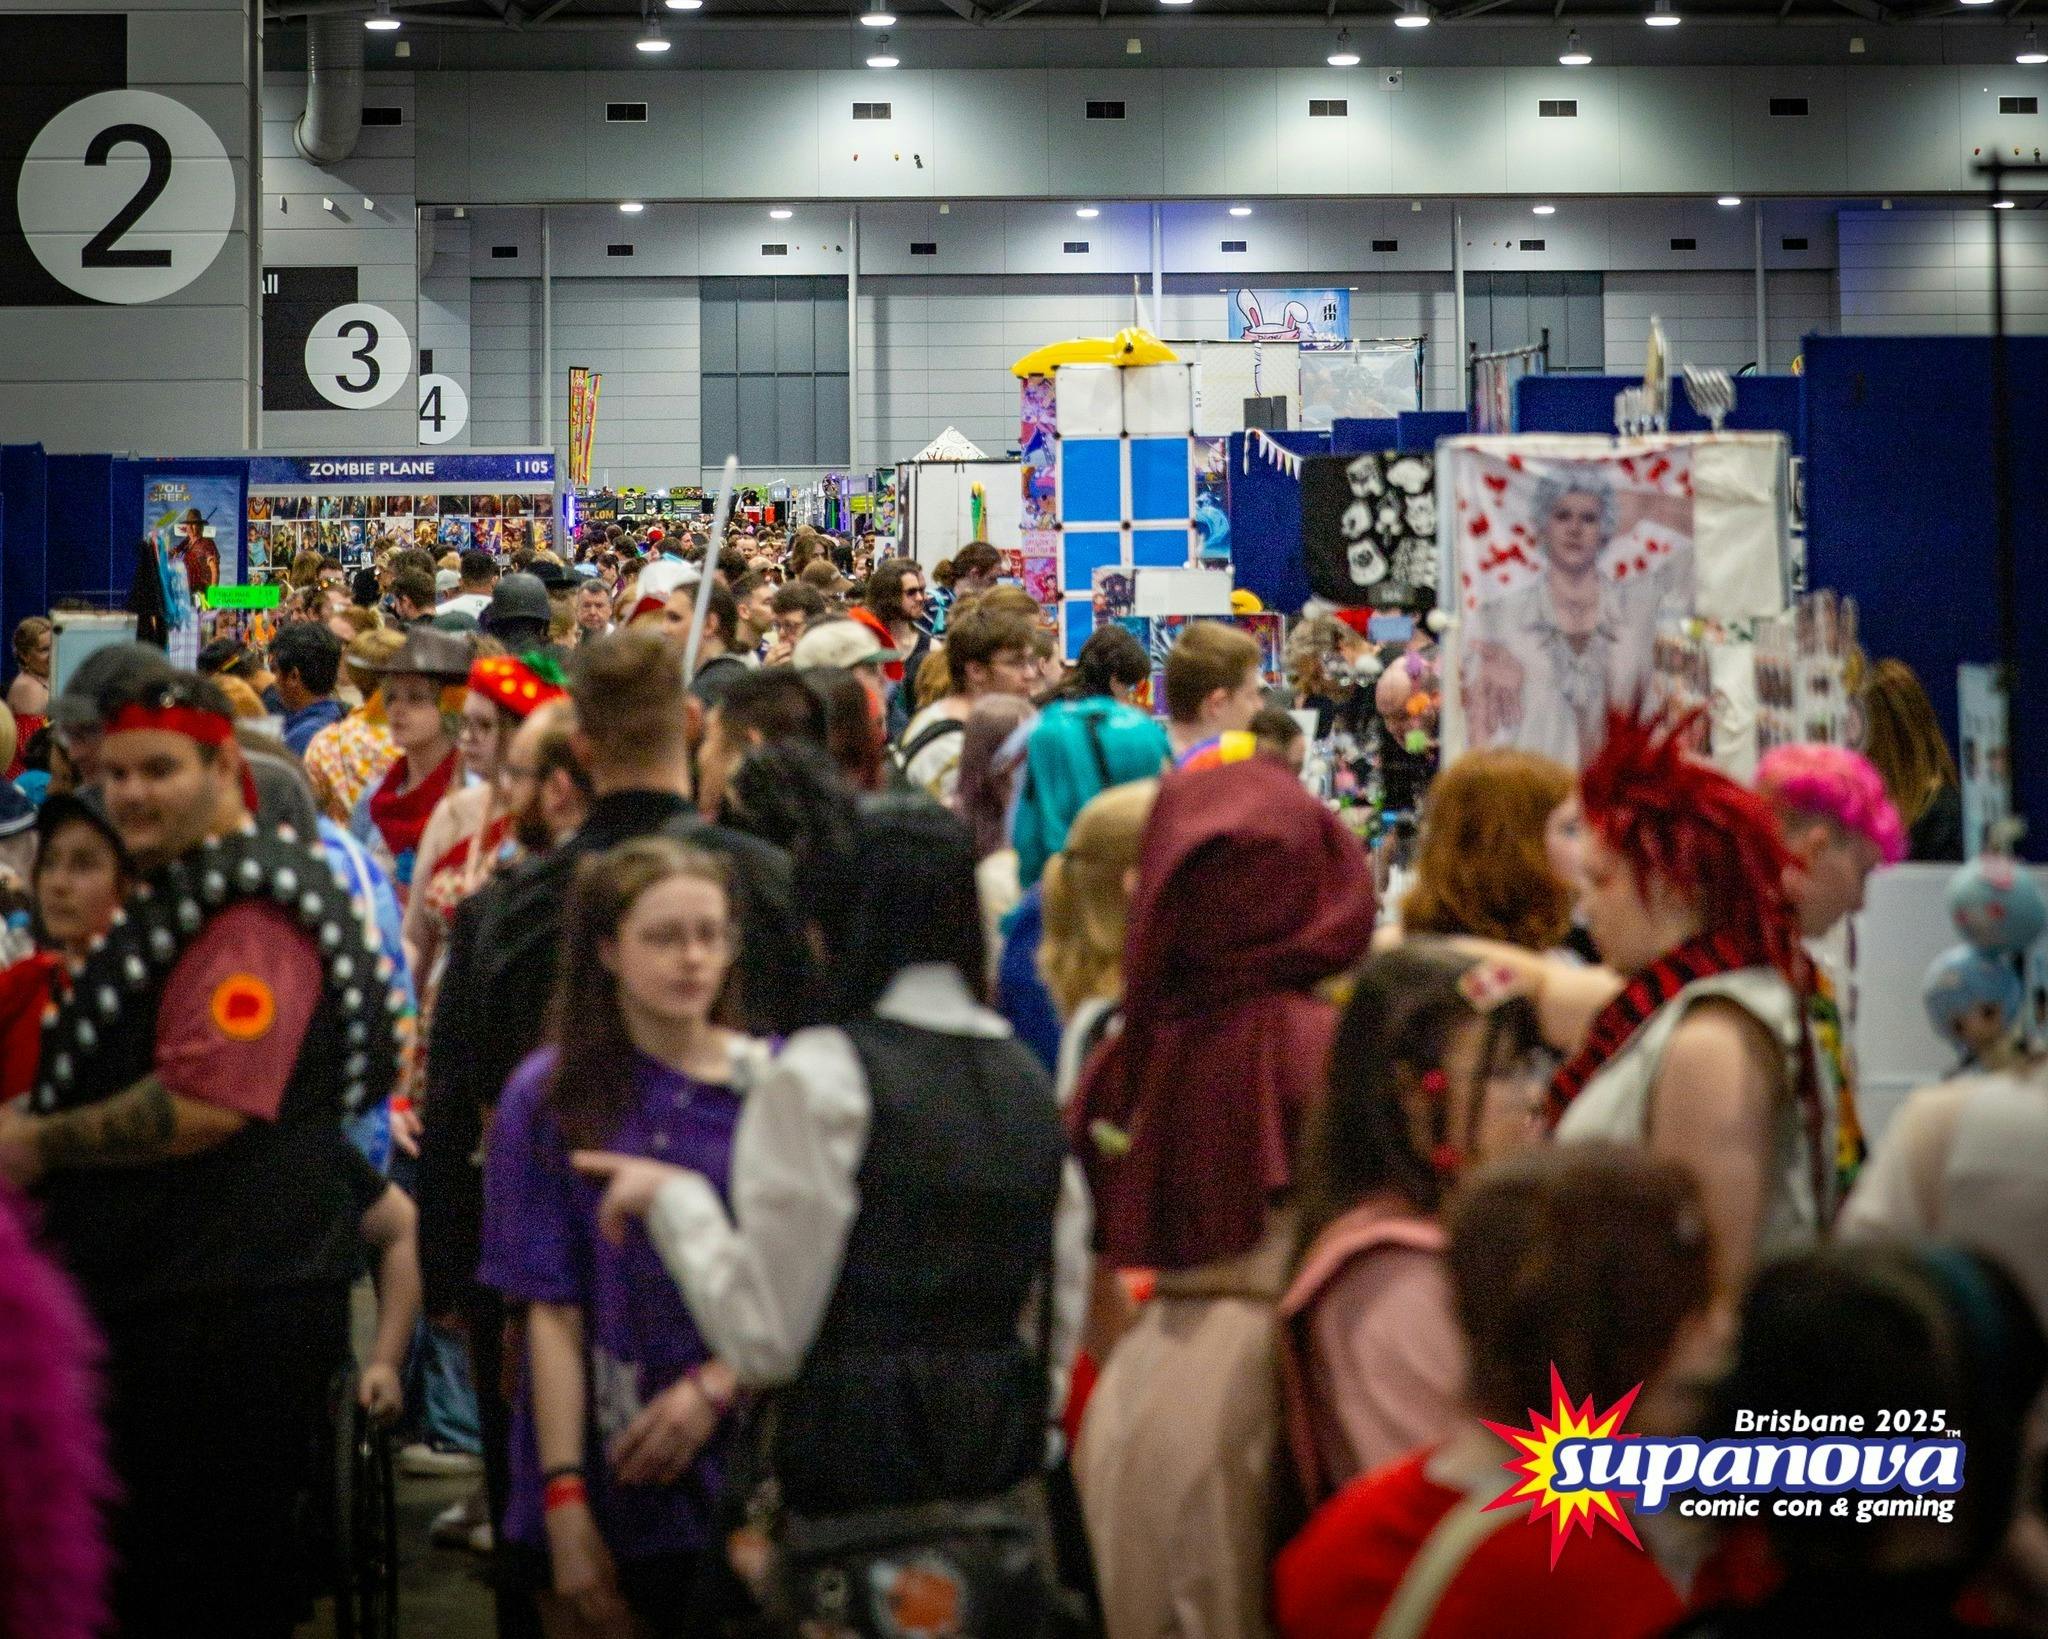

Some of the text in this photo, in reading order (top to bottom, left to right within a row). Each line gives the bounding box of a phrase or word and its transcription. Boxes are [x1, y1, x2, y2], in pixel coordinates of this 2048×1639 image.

[81, 123, 172, 268] 2
[335, 320, 381, 394] 3
[419, 385, 446, 433] 4
[309, 461, 548, 476] ZOMBIE PLANE 1105
